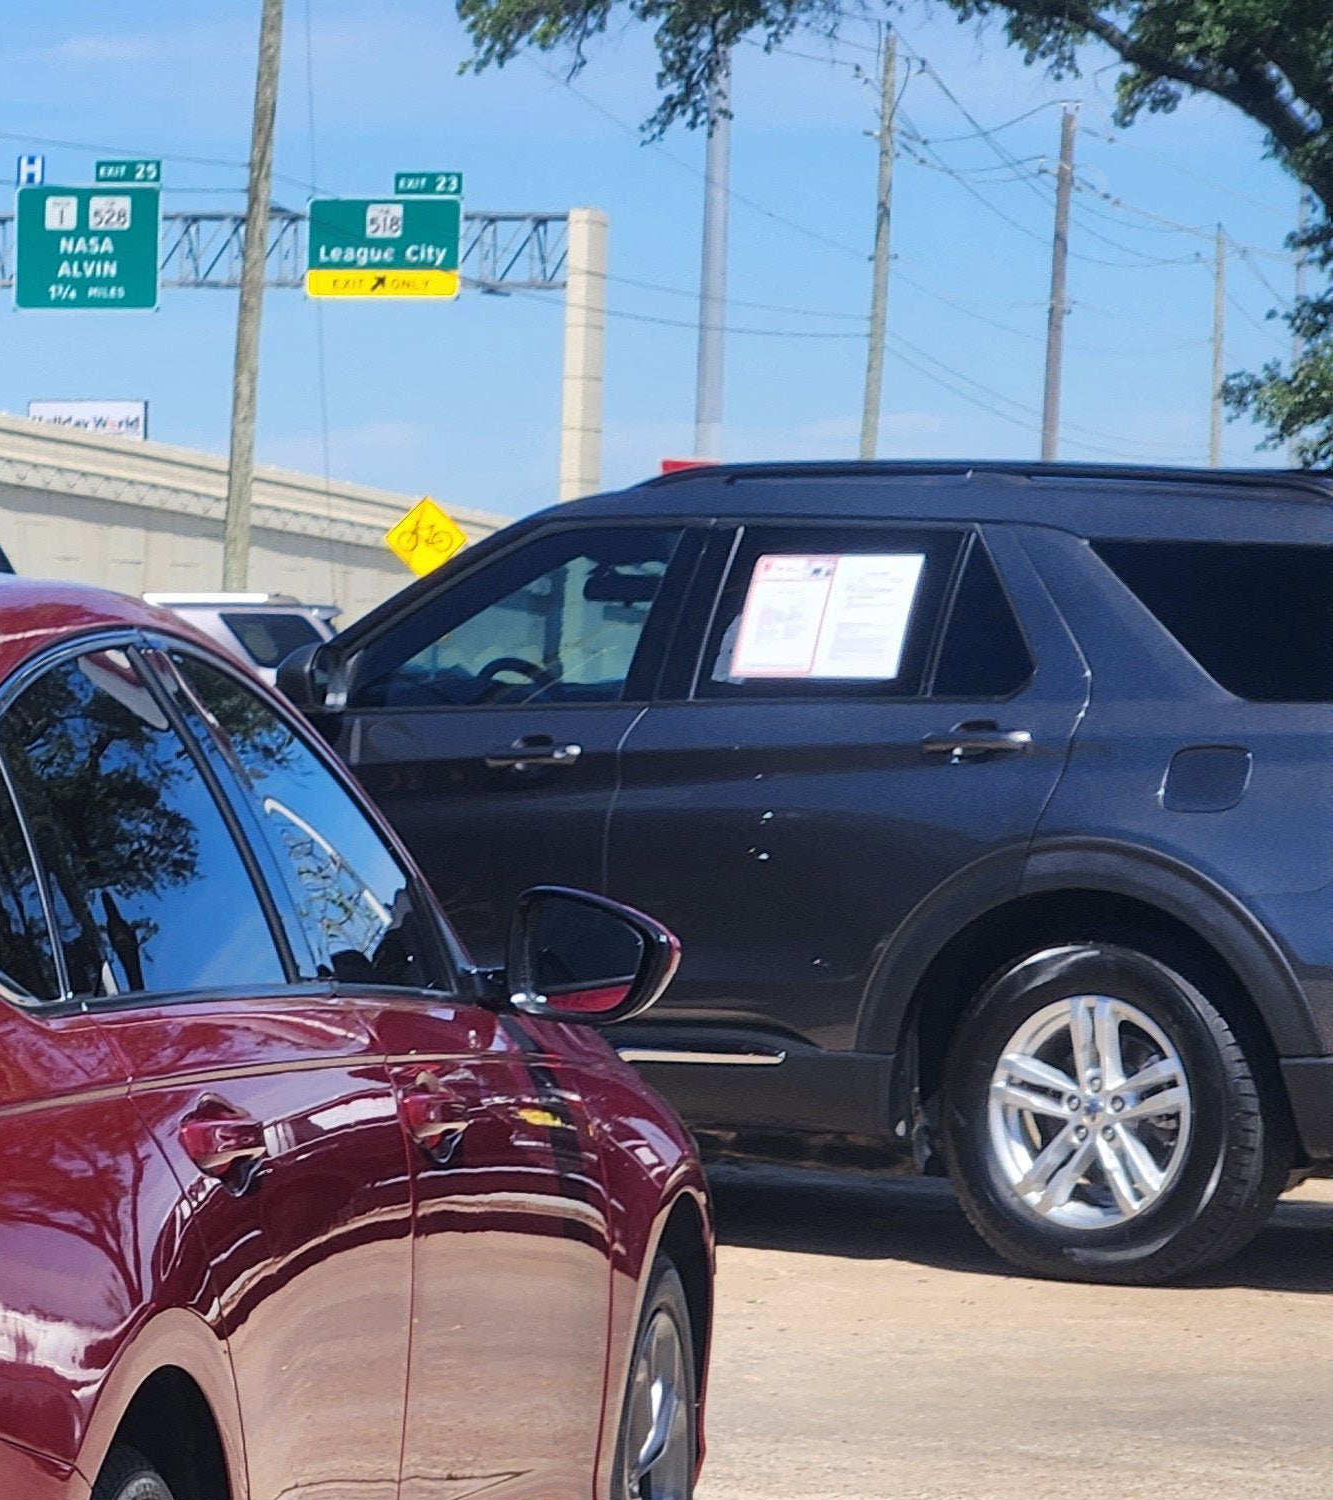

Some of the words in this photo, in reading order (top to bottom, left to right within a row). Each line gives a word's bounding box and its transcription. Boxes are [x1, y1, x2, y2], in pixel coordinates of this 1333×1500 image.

[99, 164, 127, 179] EXIT
[134, 162, 157, 180] 25
[398, 177, 427, 190] EXIT
[435, 175, 459, 193] 23
[93, 208, 128, 226] 528
[369, 216, 401, 235] 518
[59, 236, 114, 255] NASA
[319, 244, 396, 266] League
[405, 243, 447, 266] City
[57, 260, 118, 279] ALVIN
[87, 285, 126, 300] MILES
[332, 278, 365, 291] EXIT
[391, 278, 431, 291] ONLY
